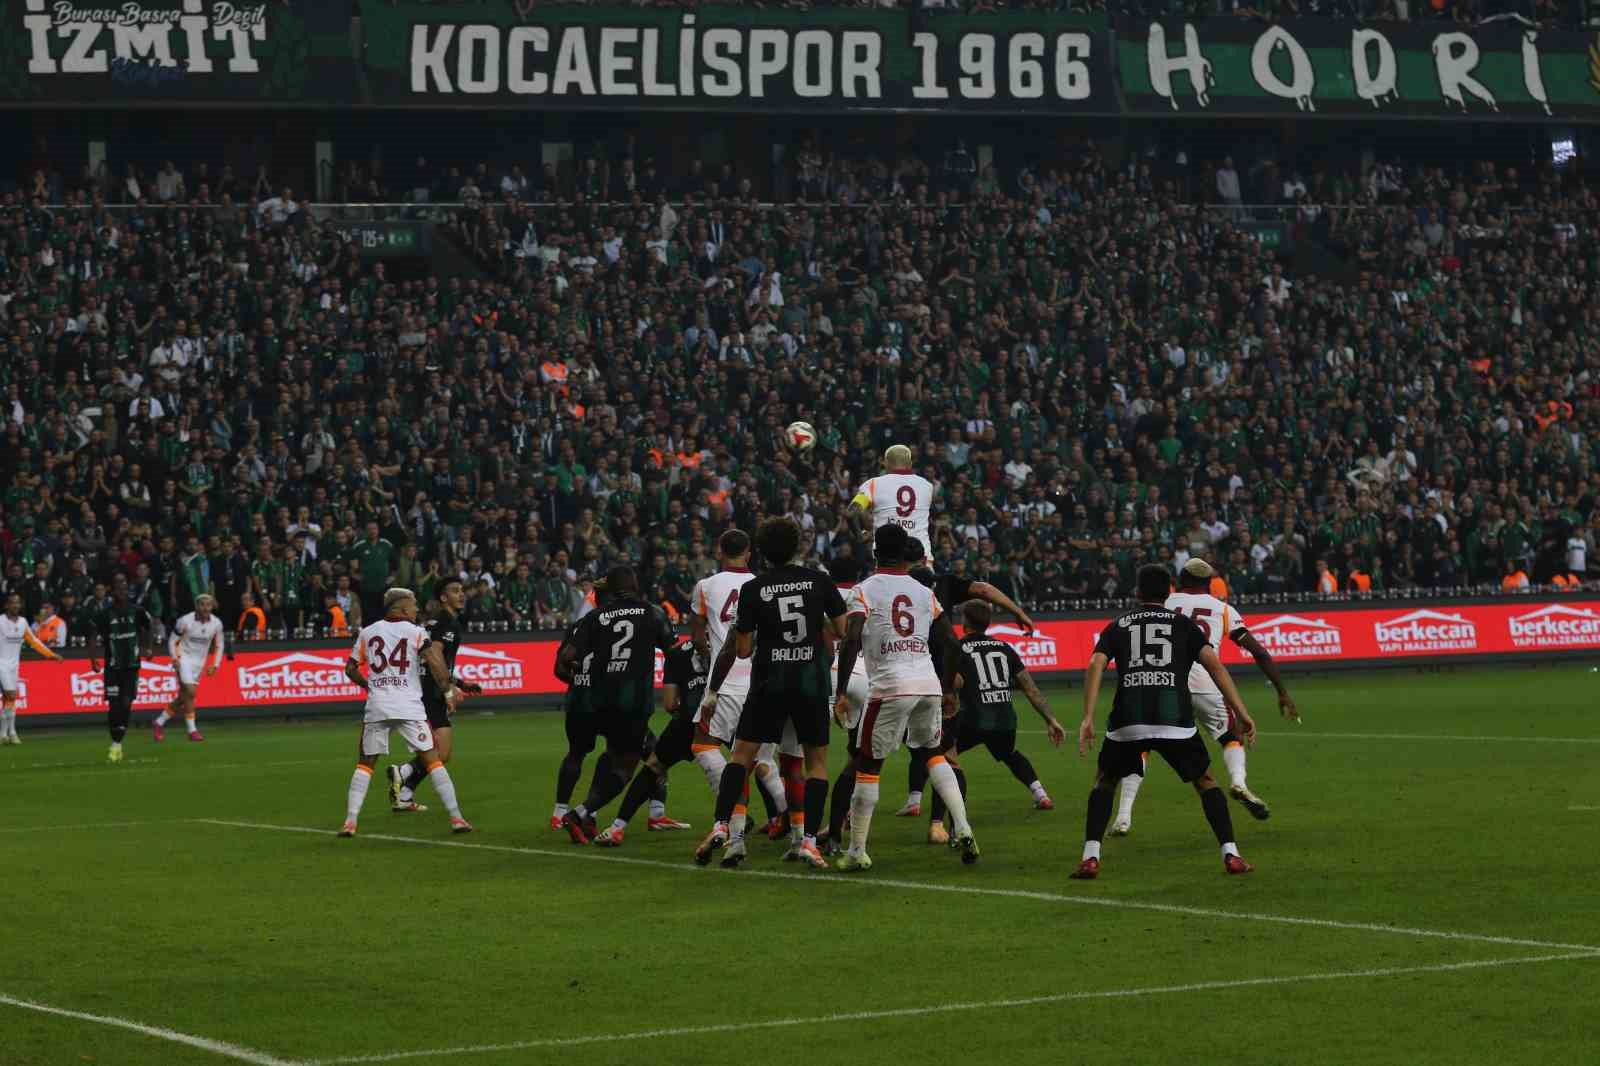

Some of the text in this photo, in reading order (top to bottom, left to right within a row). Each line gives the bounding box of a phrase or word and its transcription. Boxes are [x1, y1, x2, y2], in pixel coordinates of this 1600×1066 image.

[119, 2, 182, 26] Basra
[410, 14, 1094, 100] KOCAELİSPOR 1966
[896, 485, 917, 518] 9
[766, 581, 814, 595] AUTOPORT
[603, 607, 646, 620] AUTOPORT
[776, 595, 808, 644] 5
[891, 594, 915, 638] 6
[1124, 611, 1176, 623] AUTOPORT
[611, 619, 635, 660] 2
[1253, 626, 1341, 647] erkecan
[1374, 620, 1476, 642] berkecan
[367, 635, 410, 676] 34
[880, 640, 927, 655] SANCHEZ
[1128, 623, 1173, 668] 15
[970, 651, 1010, 690] 10
[1123, 671, 1176, 688] SERBEST
[241, 690, 269, 700] YAPI
